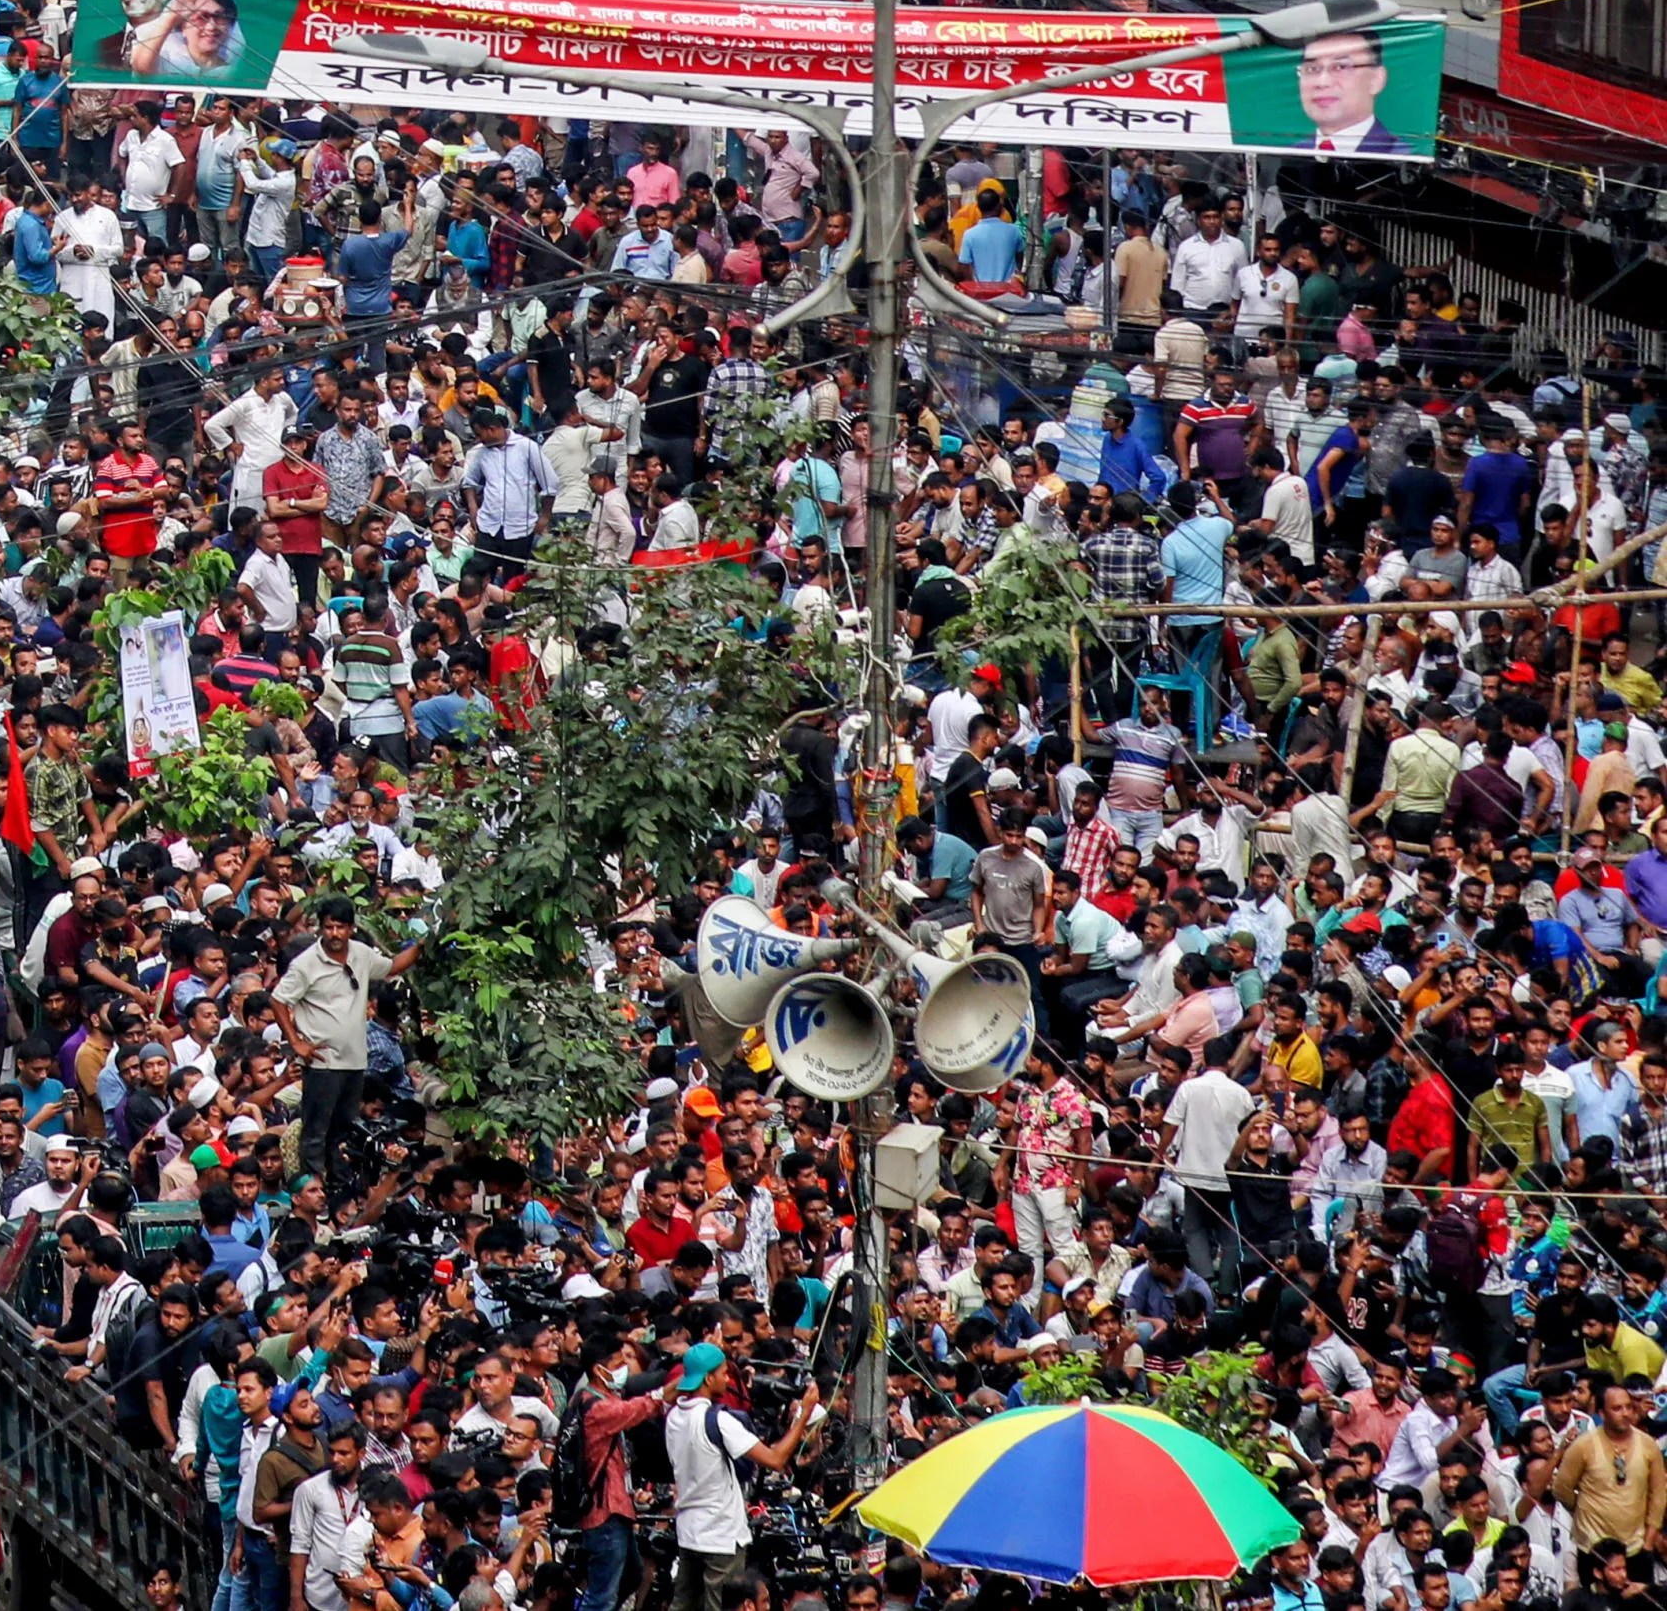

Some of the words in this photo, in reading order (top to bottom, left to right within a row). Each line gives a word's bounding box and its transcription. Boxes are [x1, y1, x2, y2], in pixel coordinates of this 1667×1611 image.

[638, 8, 667, 24] অব
[935, 19, 1009, 44] বেগম
[1018, 22, 1114, 44] খালেদা
[537, 34, 630, 64] মামলা
[1147, 67, 1209, 97] হবে
[1007, 98, 1205, 133] দক্ষিণ
